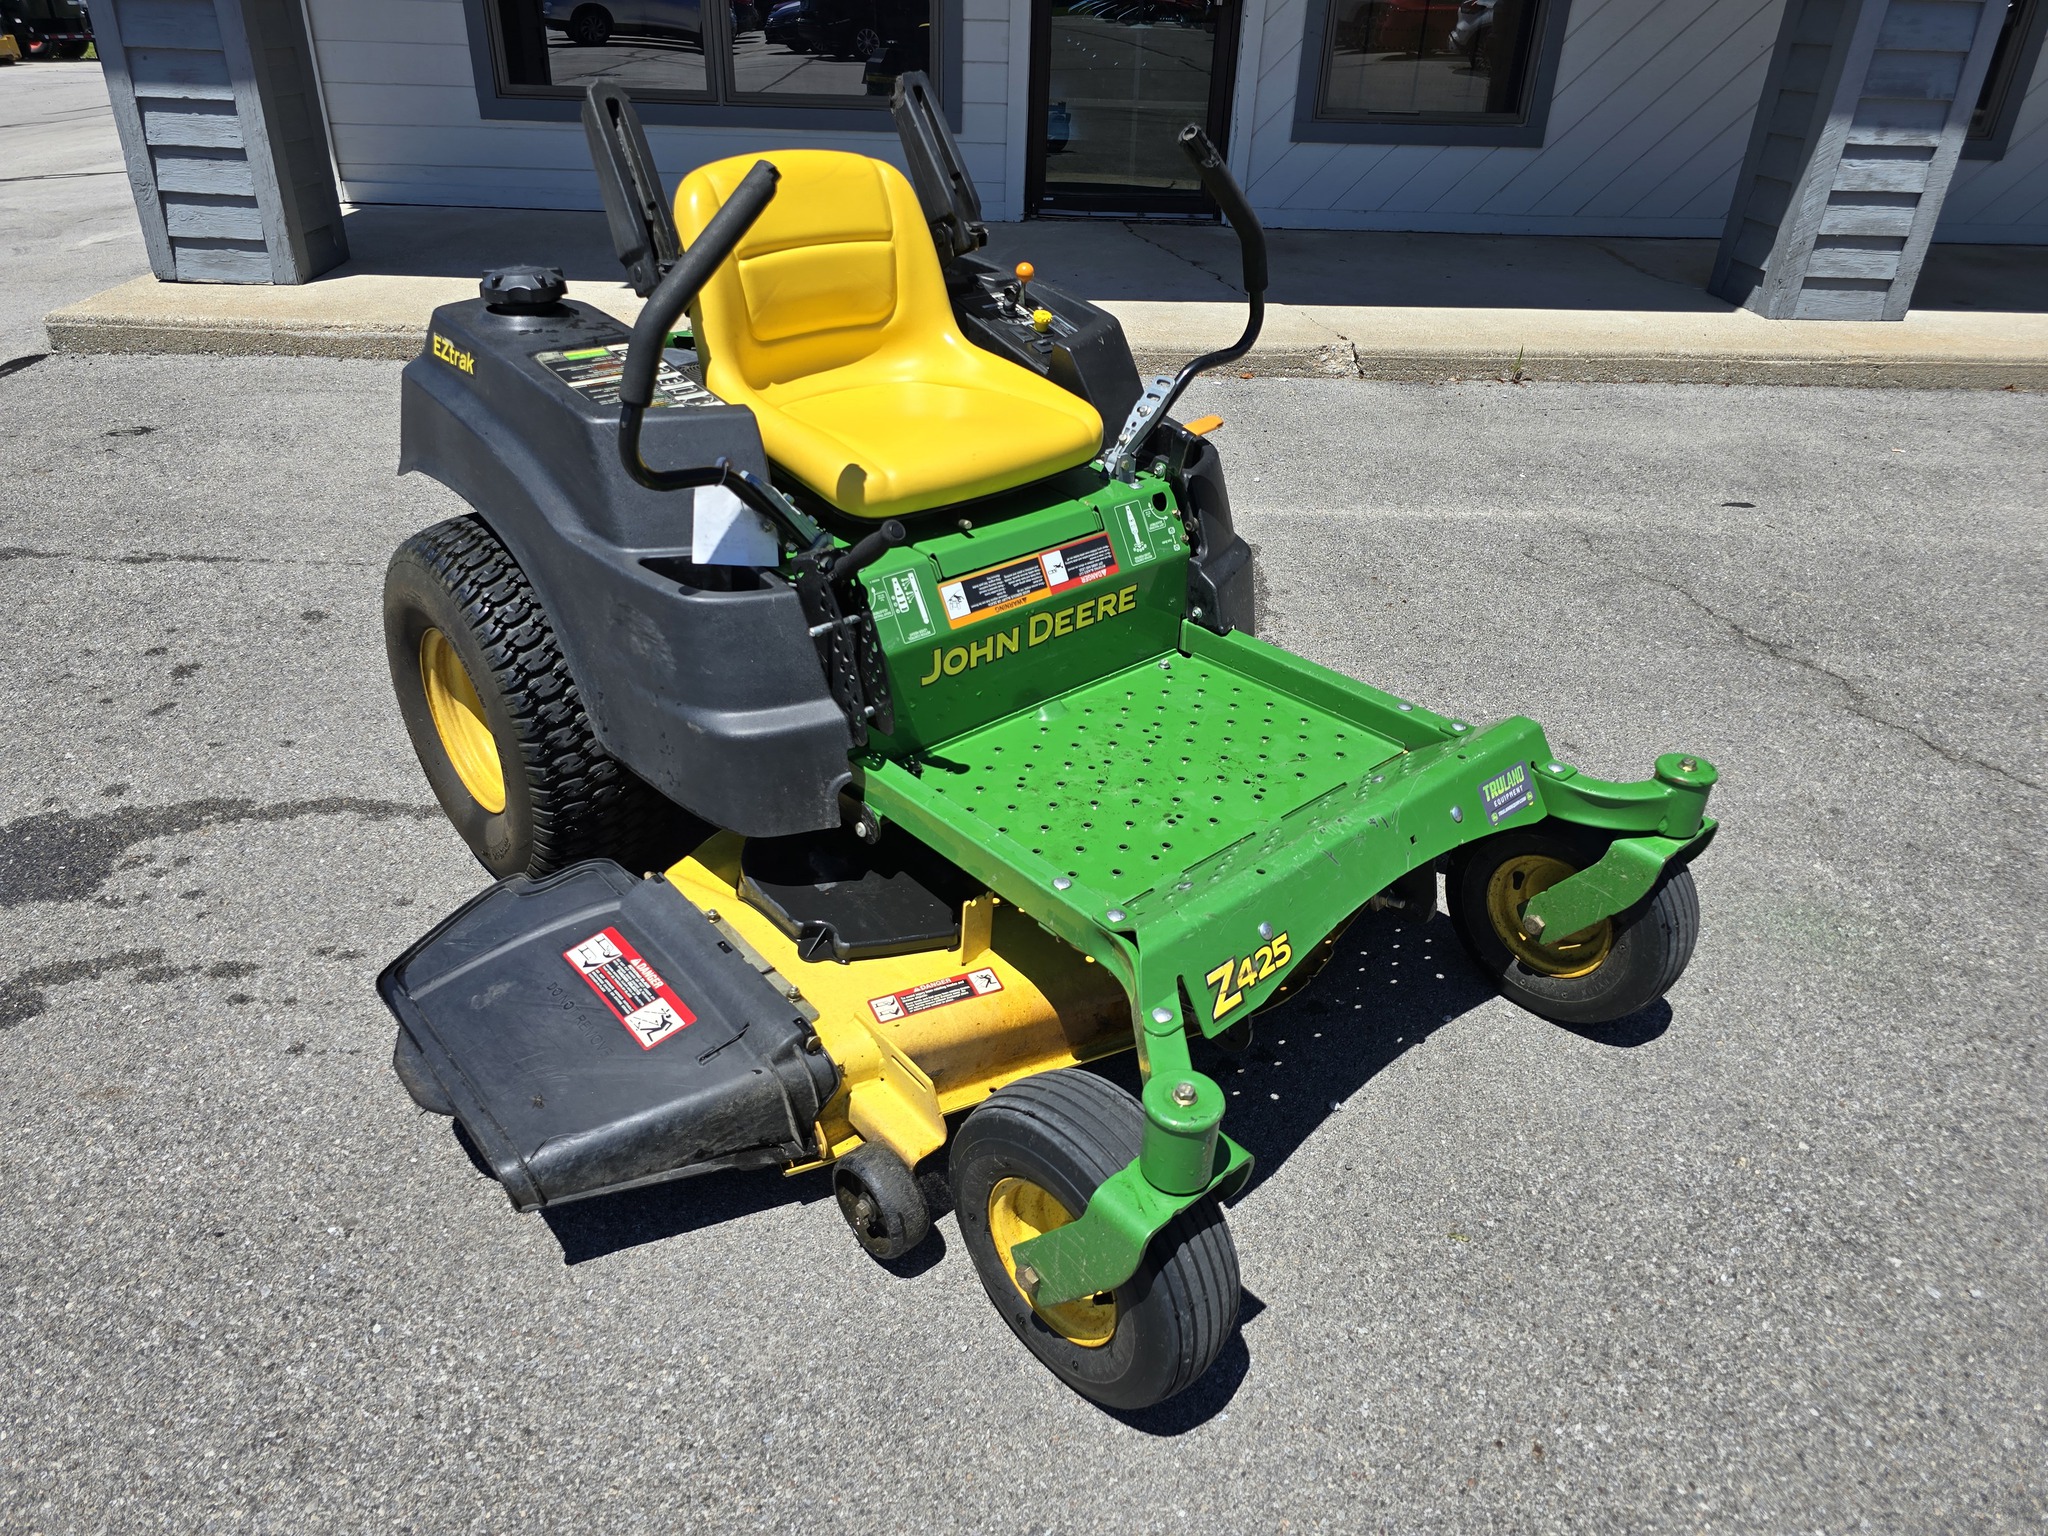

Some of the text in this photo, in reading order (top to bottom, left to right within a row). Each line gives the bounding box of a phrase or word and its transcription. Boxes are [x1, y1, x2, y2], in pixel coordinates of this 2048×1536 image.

[433, 334, 475, 375] EZtrak
[1080, 570, 1103, 584] DANGER
[994, 597, 1023, 613] WARNING
[920, 626, 1020, 687] JOHN
[1028, 583, 1138, 647] DEERE
[1483, 765, 1525, 802] TRULAND
[1493, 785, 1524, 807] EQUIPMENT
[637, 963, 665, 989] DANGER
[920, 977, 952, 991] DANGER
[1205, 931, 1292, 1023] Z425
[547, 982, 563, 997] DO
